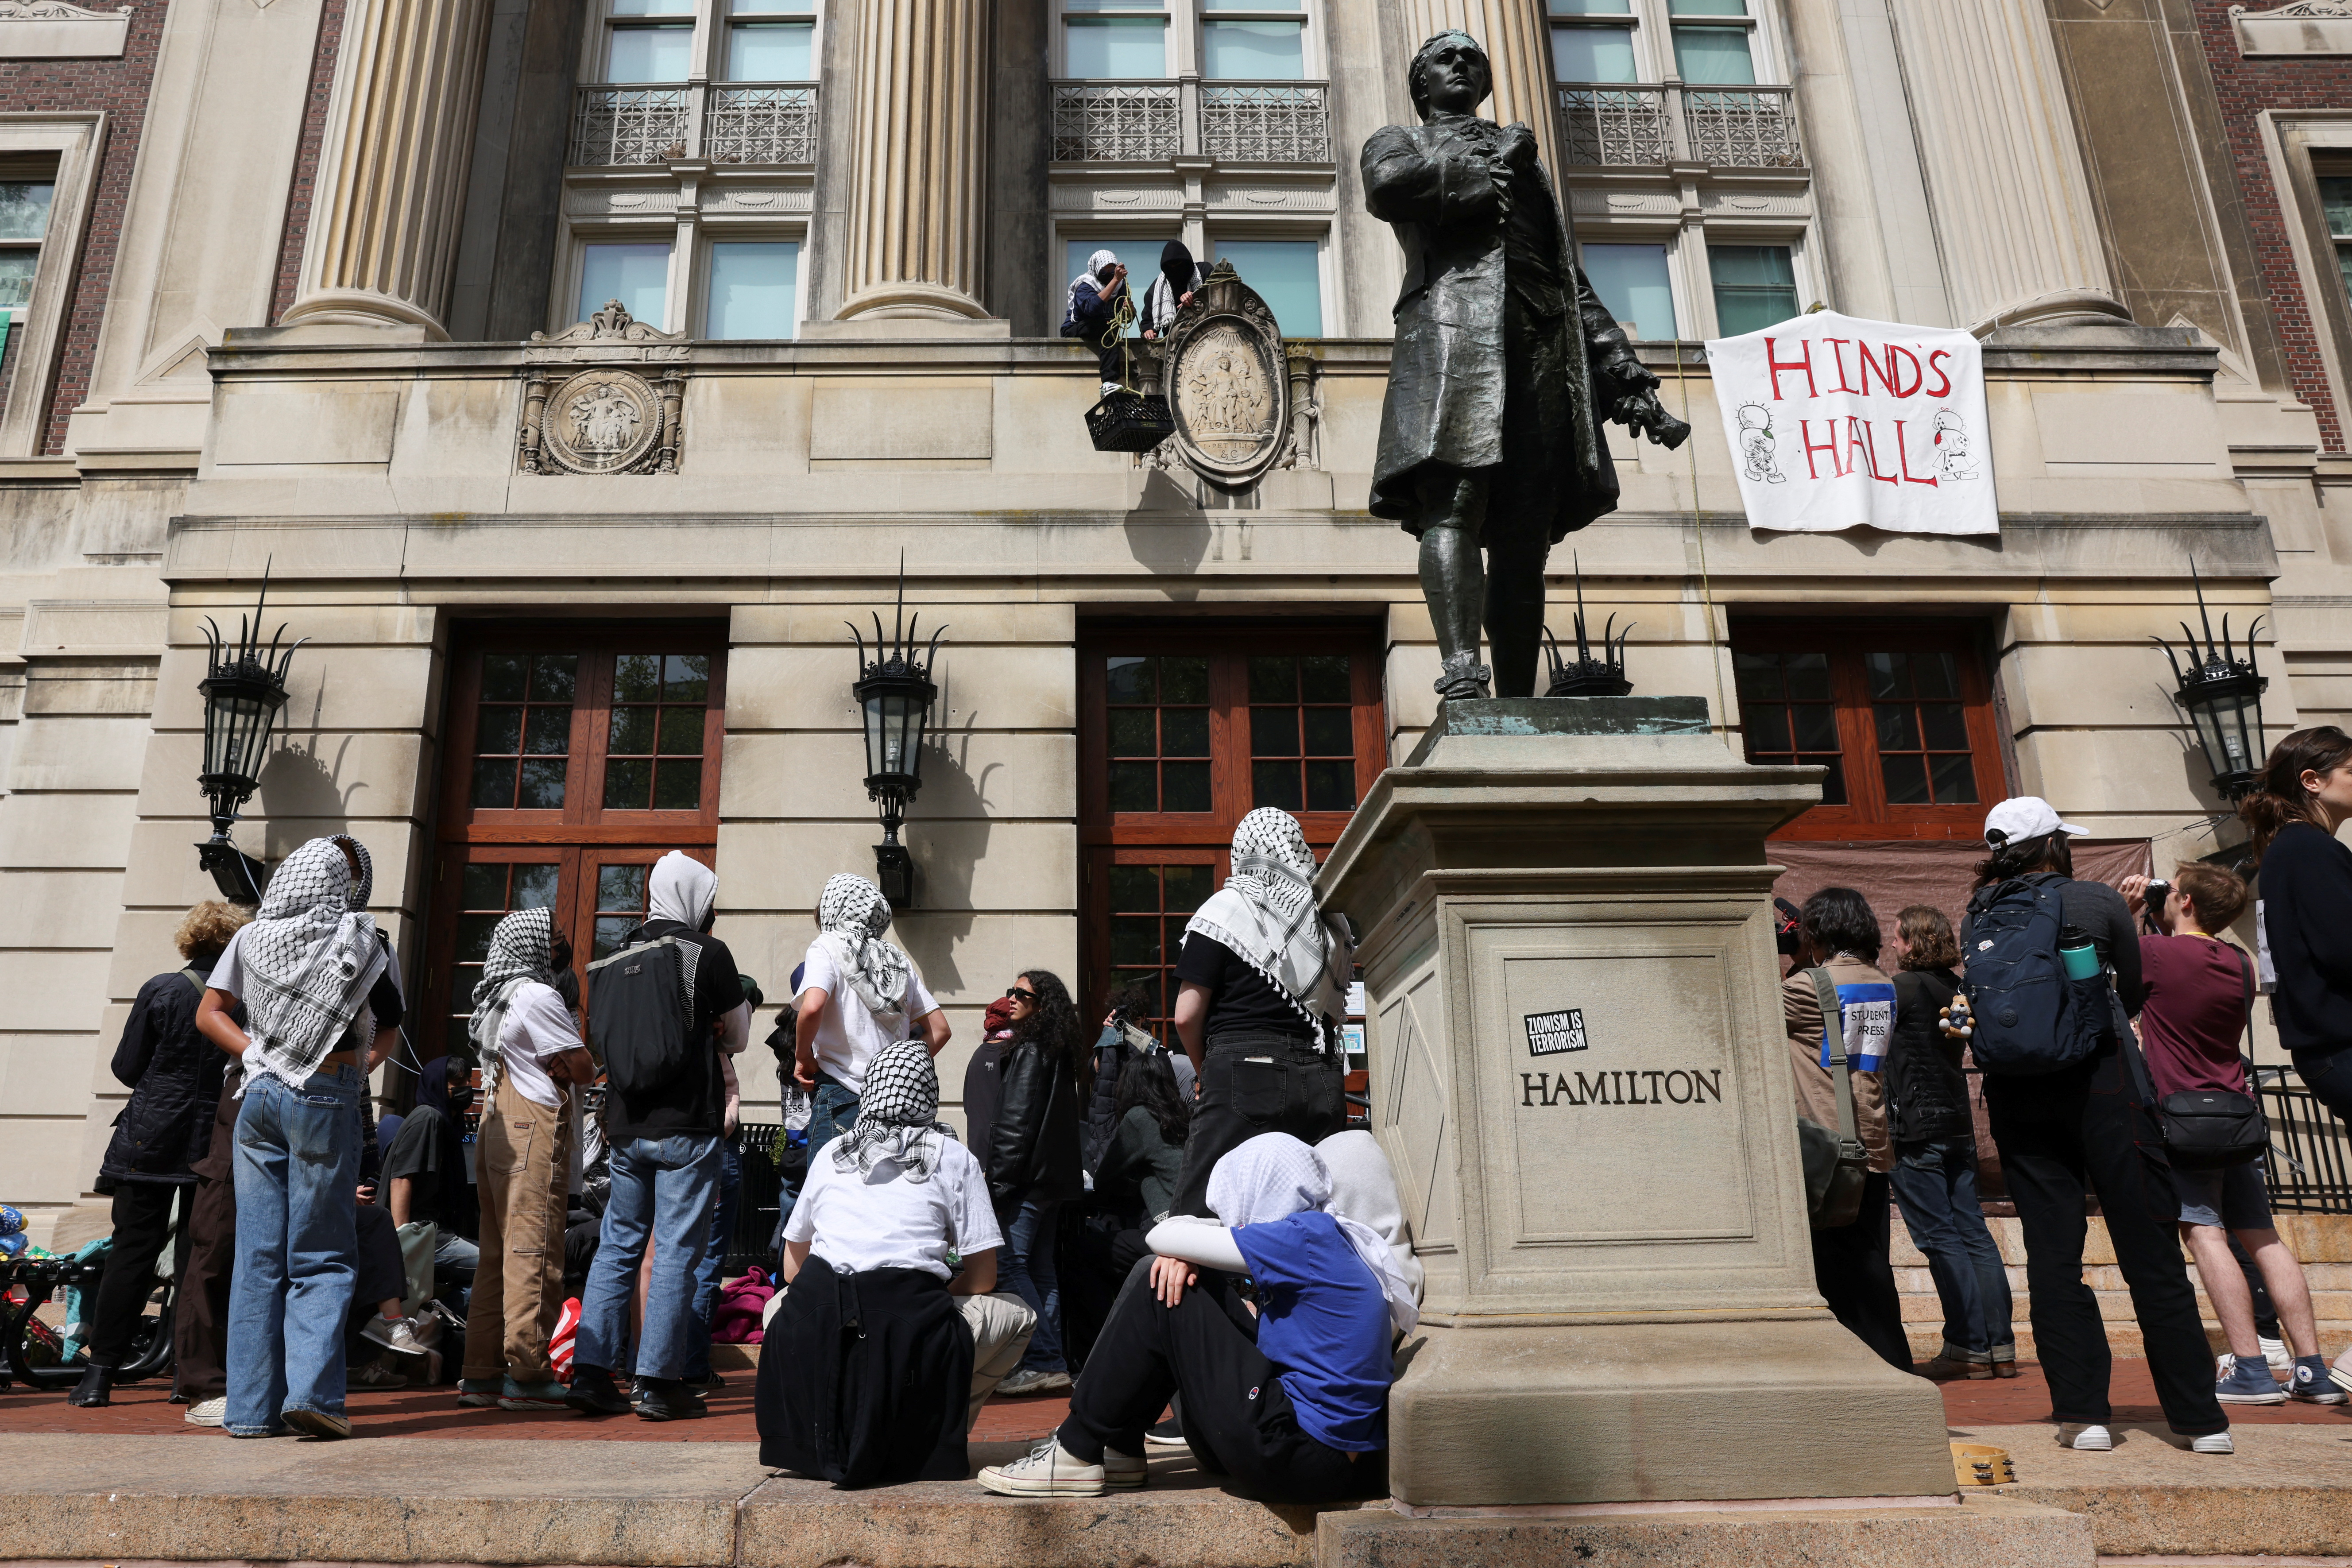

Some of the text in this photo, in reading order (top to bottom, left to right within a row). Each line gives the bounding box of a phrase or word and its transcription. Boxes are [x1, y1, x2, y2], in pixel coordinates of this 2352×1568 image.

[1189, 341, 1207, 364] LUMINE
[549, 379, 583, 415] AMERICA
[627, 377, 655, 412] SIGILLUM
[1800, 415, 1938, 488] HALL
[1527, 1012, 1582, 1034] ZIONISM IS
[1852, 1010, 1889, 1021] STUDENT
[1529, 1029, 1586, 1053] TERRORISM
[1858, 1026, 1884, 1036] PRESS
[1520, 1070, 1721, 1107] HAMILTON
[782, 1104, 804, 1113] PRESS
